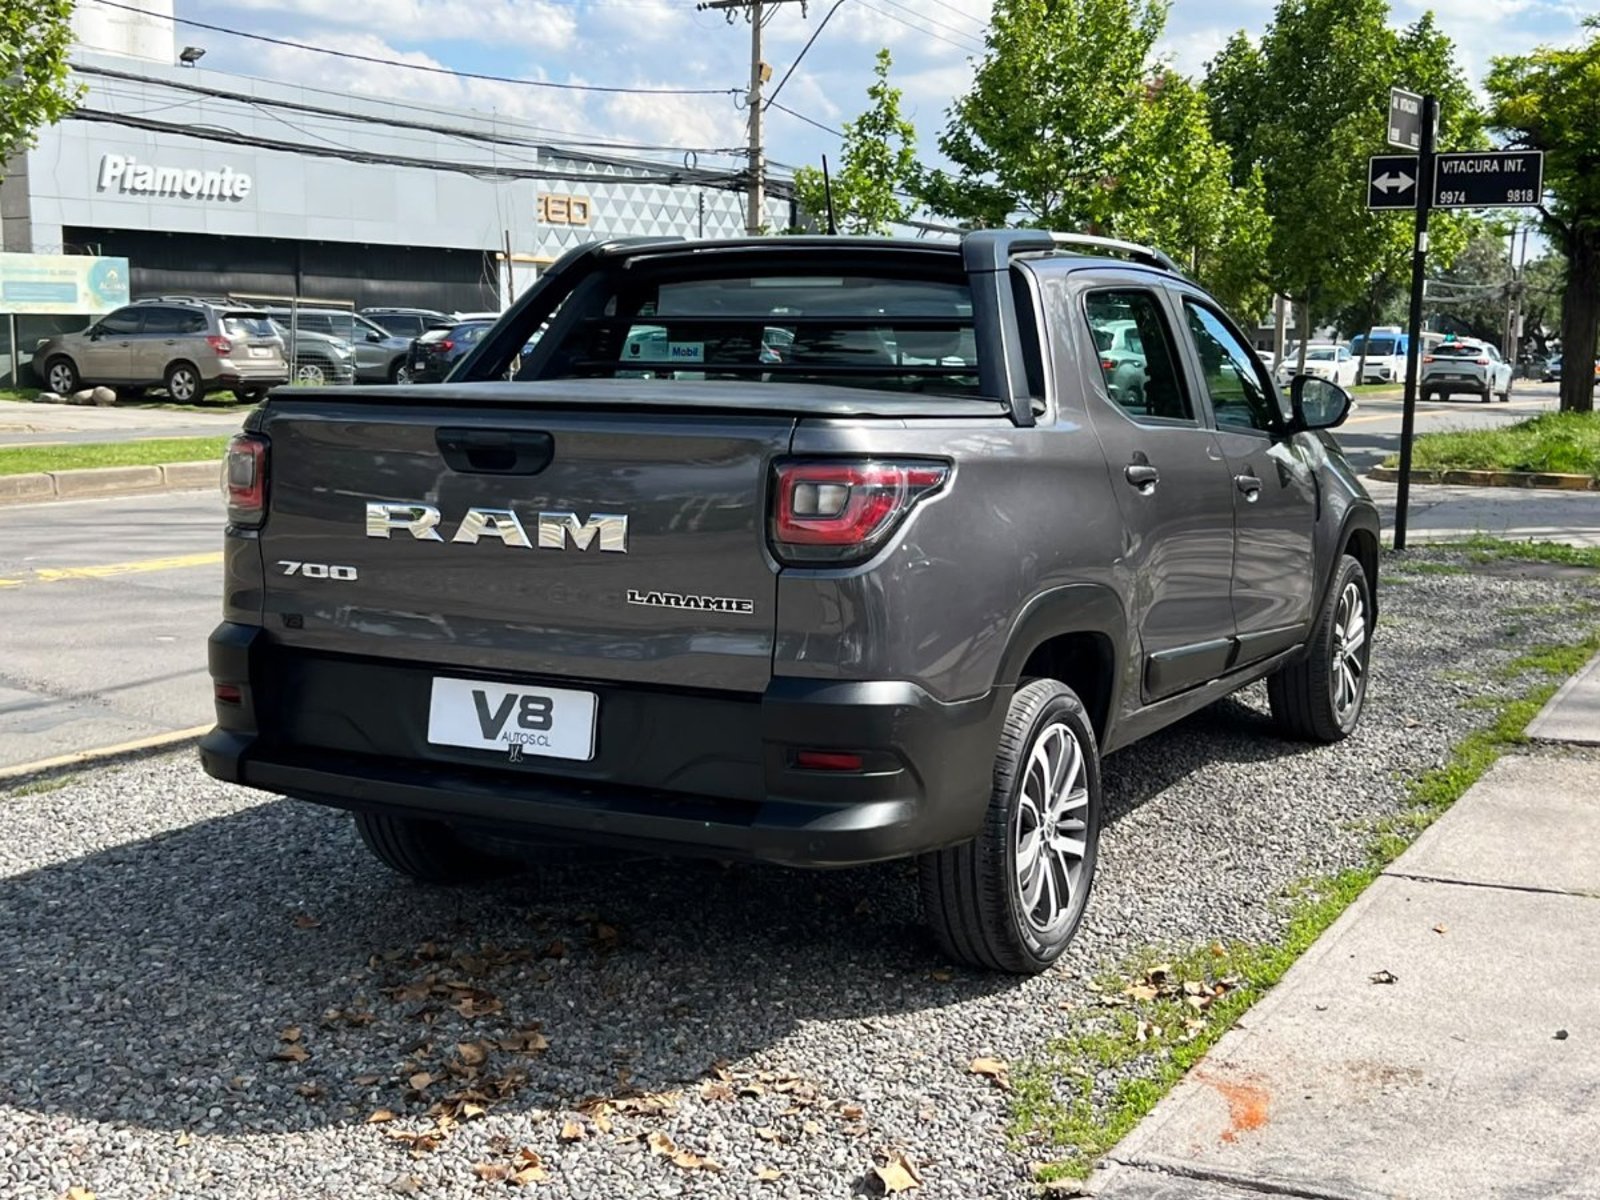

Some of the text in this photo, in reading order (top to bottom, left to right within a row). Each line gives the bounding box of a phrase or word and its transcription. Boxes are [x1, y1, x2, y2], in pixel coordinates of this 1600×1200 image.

[1442, 159, 1526, 173] VITACURA INT.
[98, 154, 252, 201] Piamonte
[1440, 191, 1466, 203] 9974
[1507, 189, 1534, 202] 9818
[366, 502, 628, 553] RAM
[277, 560, 358, 580] 700
[627, 589, 753, 614] LARAMIE
[472, 689, 554, 740] V8
[501, 731, 552, 747] AUTOS.CL
